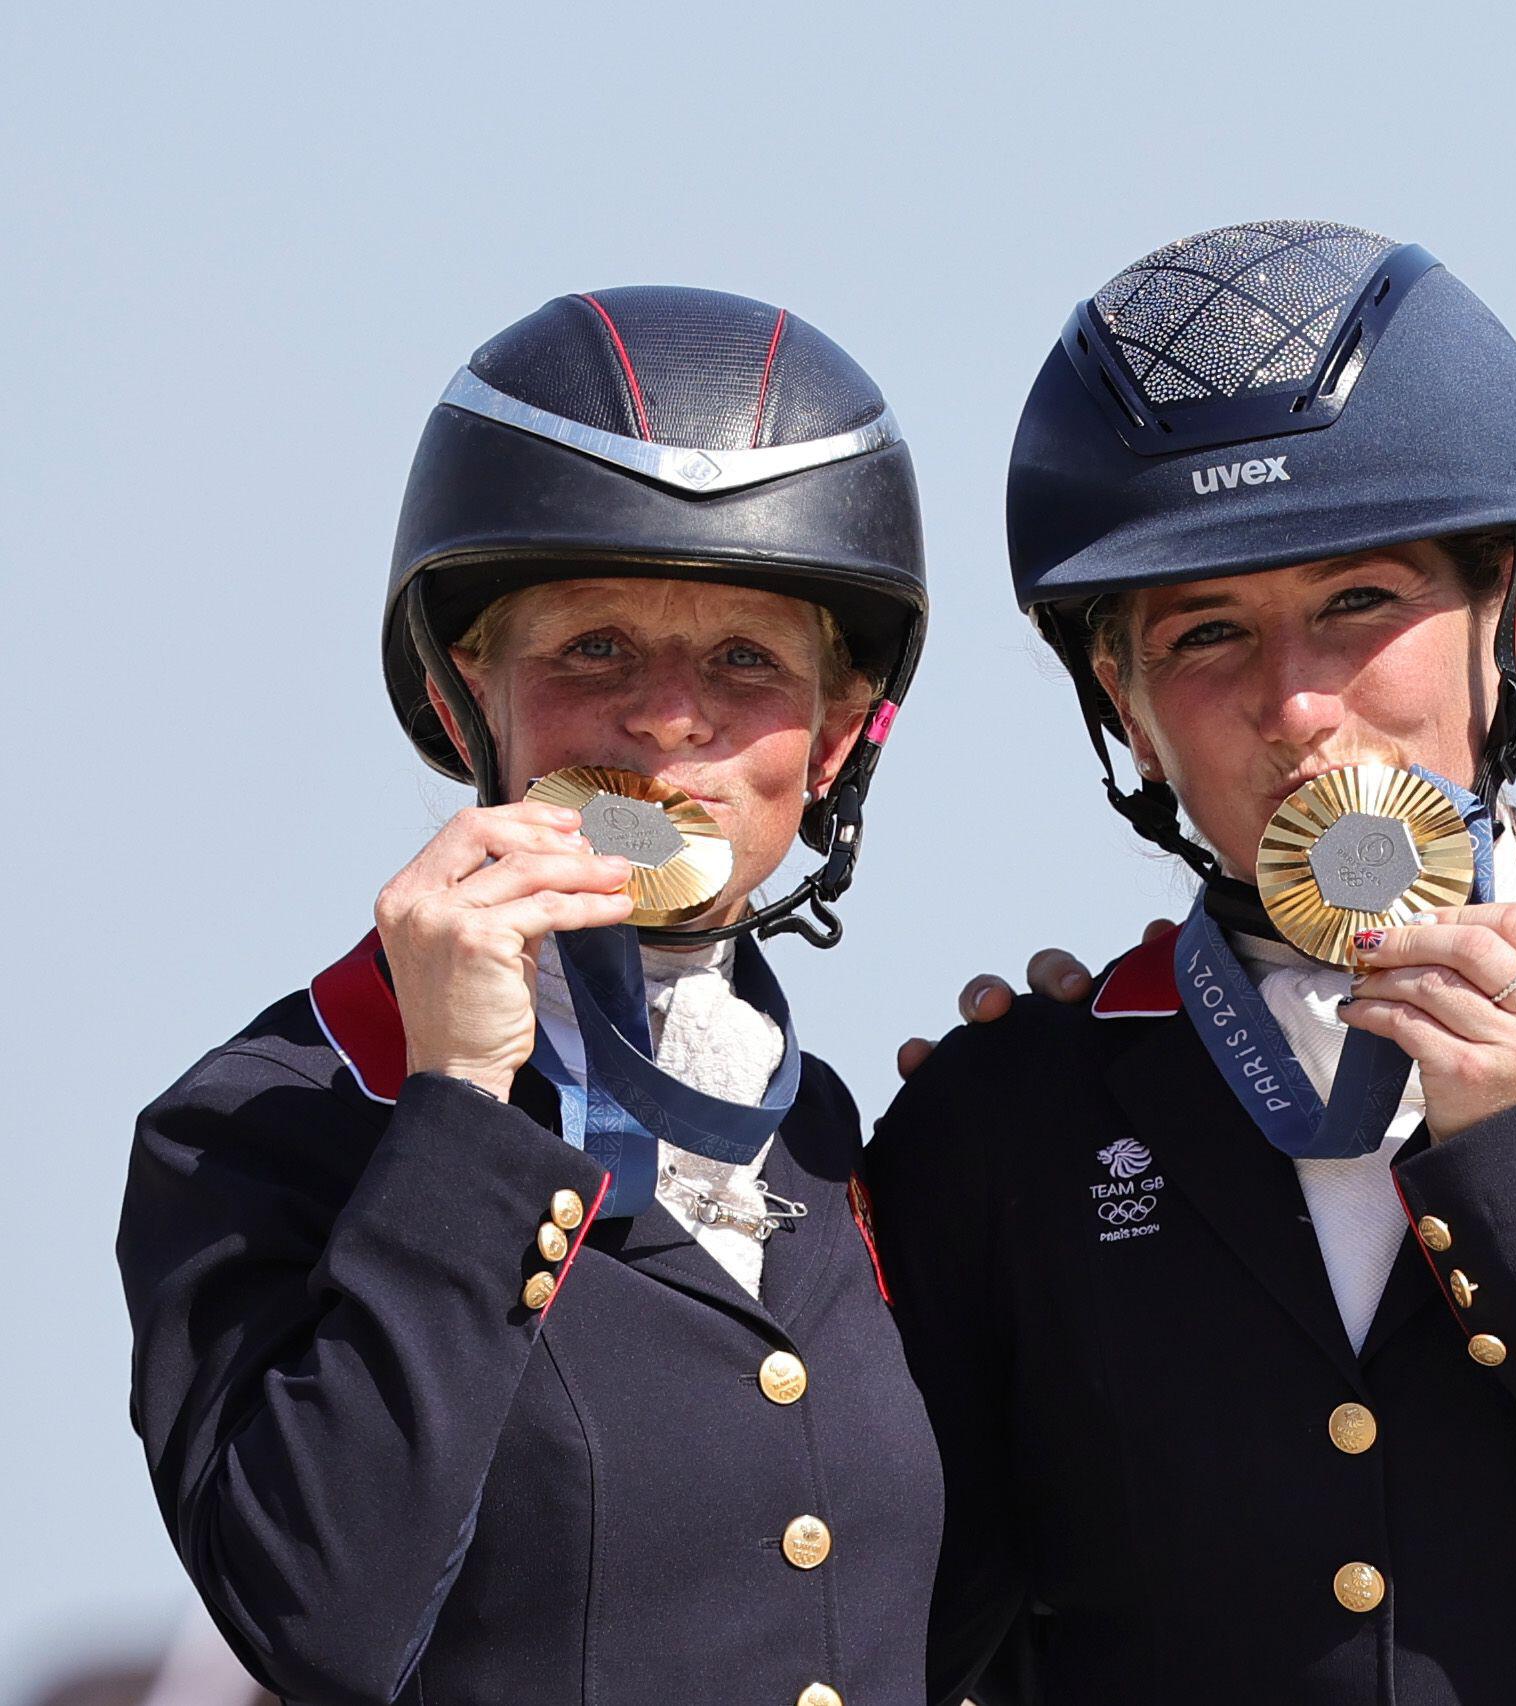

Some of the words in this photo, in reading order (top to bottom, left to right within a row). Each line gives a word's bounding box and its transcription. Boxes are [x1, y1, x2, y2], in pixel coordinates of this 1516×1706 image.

[1192, 455, 1290, 495] uvex
[1089, 1181, 1135, 1199] TEAM
[1140, 1176, 1165, 1192] GB
[1131, 1223, 1160, 1237] 2024
